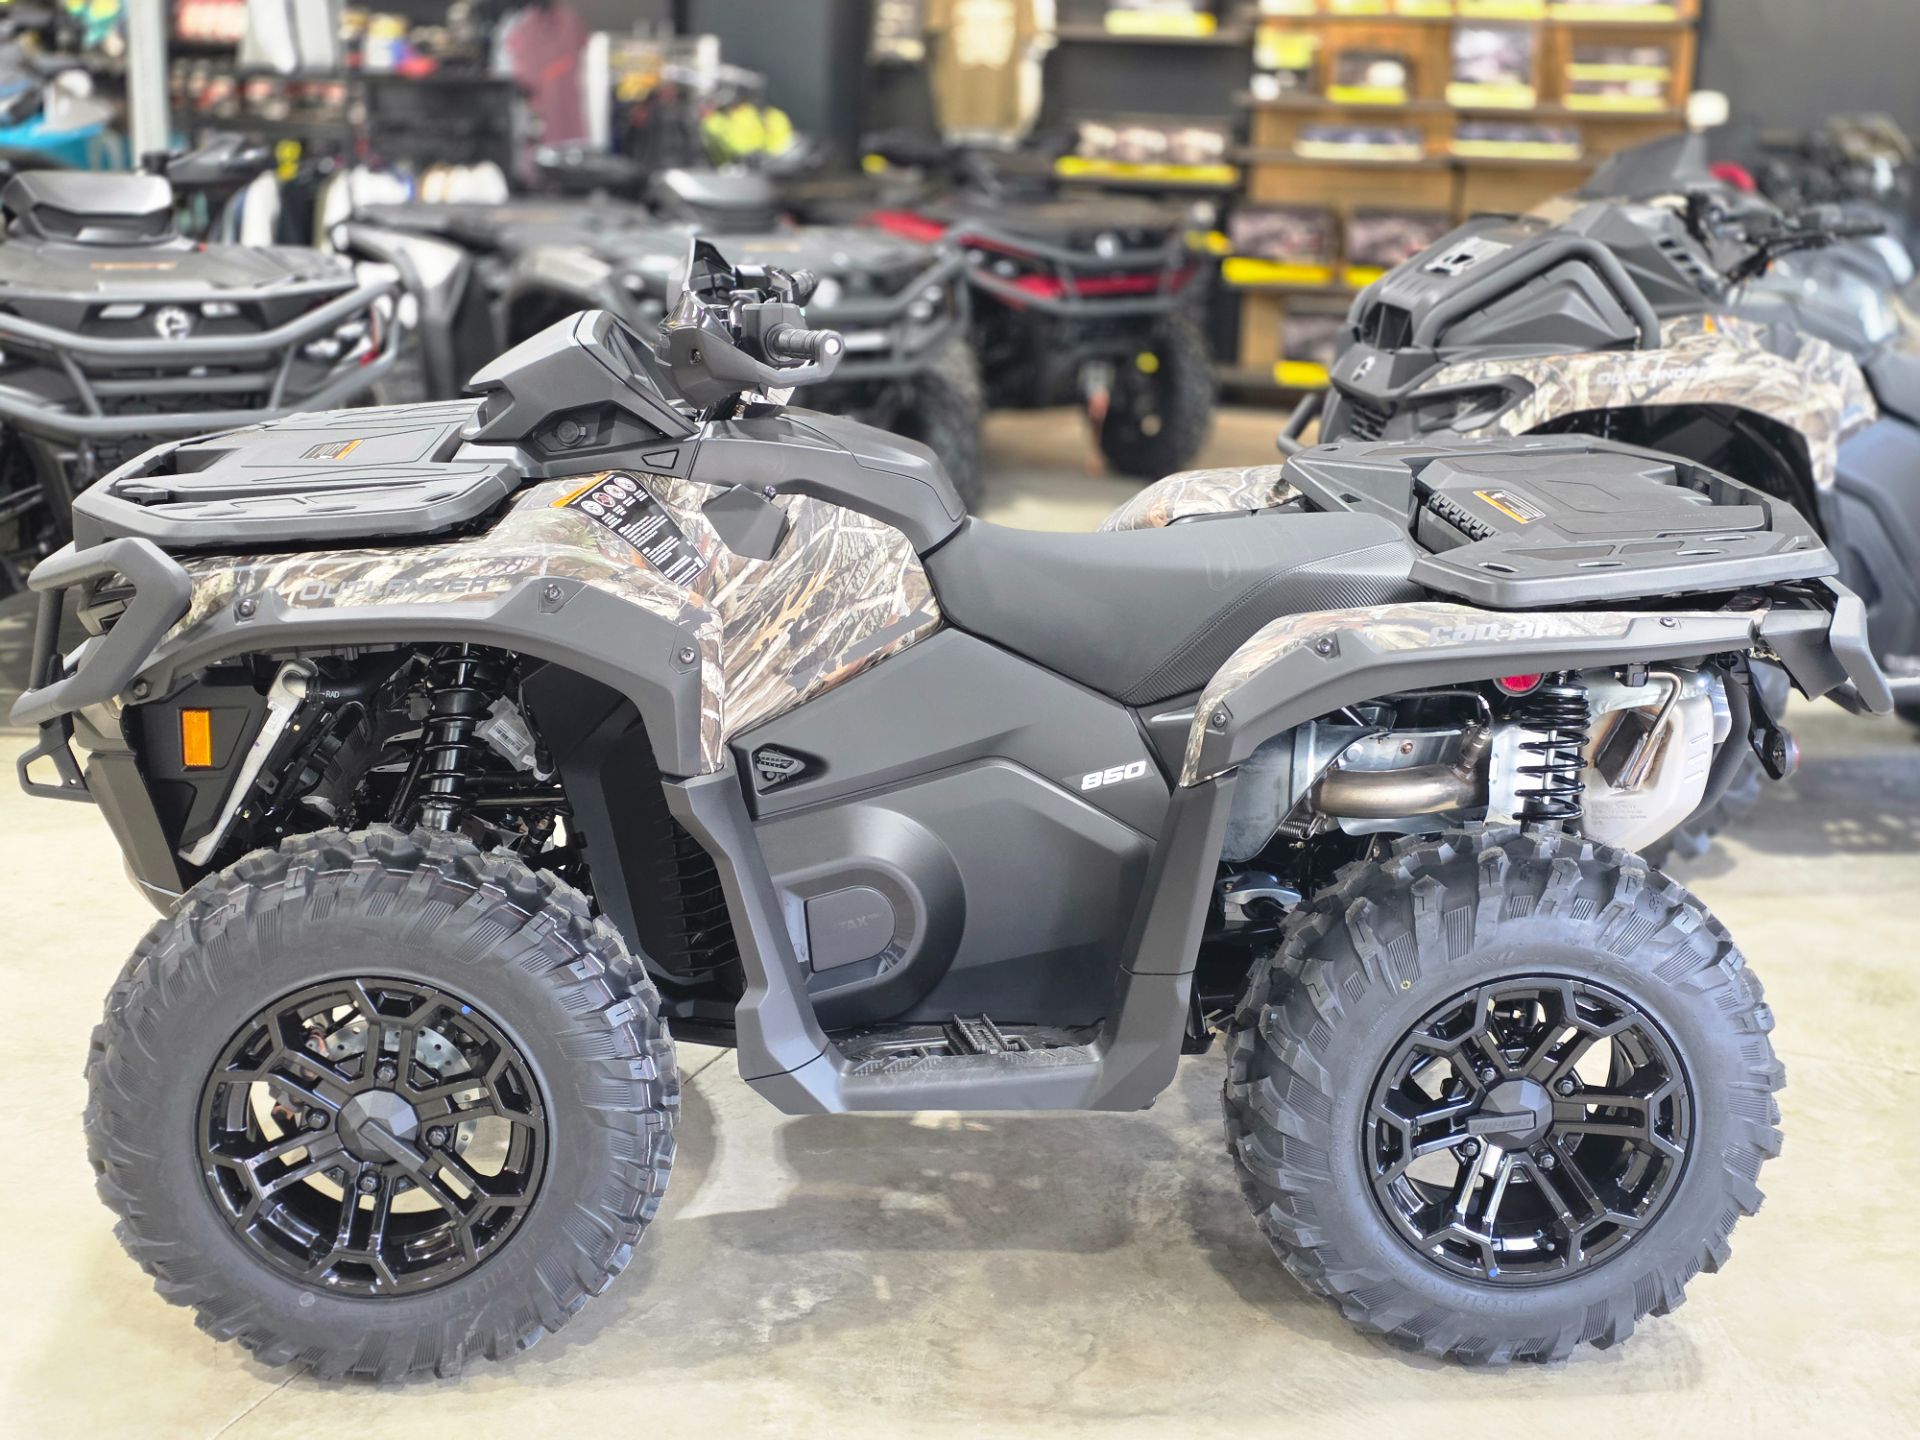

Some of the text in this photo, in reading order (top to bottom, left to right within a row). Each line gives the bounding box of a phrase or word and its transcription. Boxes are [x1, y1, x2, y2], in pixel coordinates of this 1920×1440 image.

[299, 576, 491, 600] OUTLANDER
[325, 690, 340, 699] RAD
[1081, 760, 1146, 790] 850
